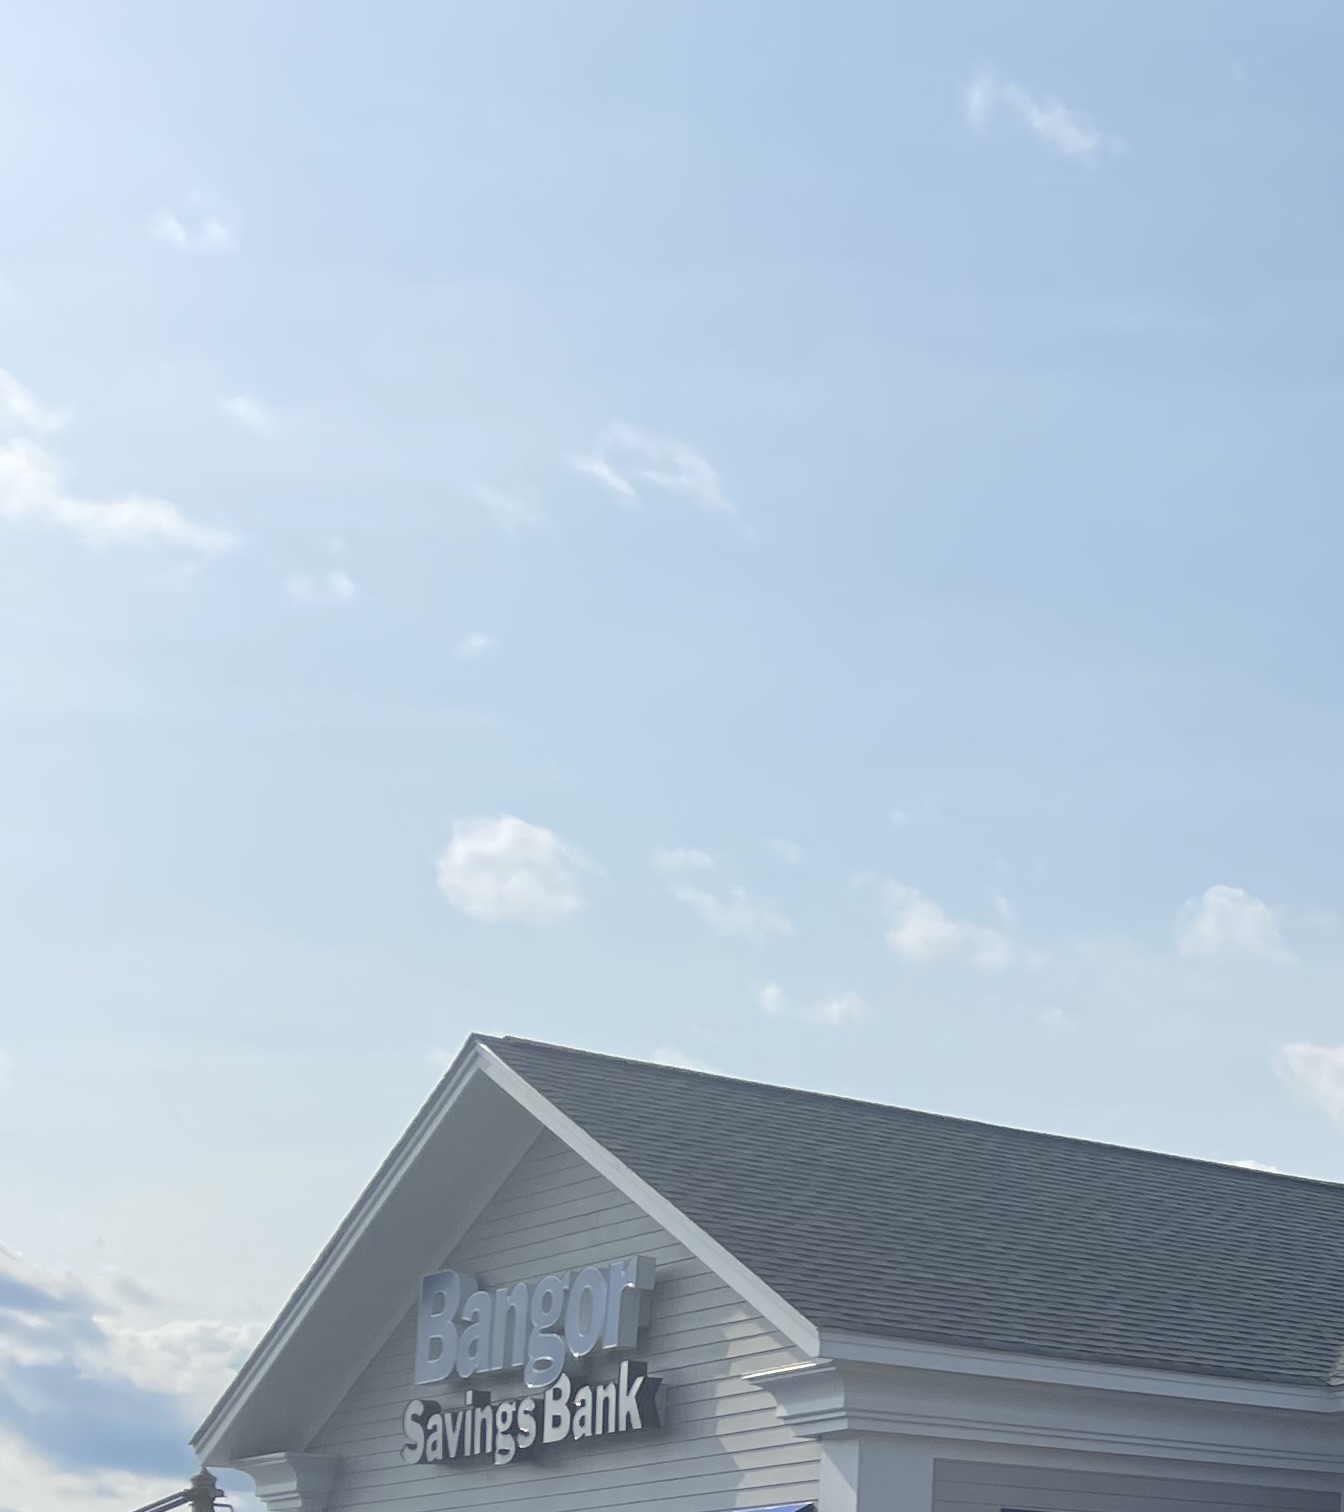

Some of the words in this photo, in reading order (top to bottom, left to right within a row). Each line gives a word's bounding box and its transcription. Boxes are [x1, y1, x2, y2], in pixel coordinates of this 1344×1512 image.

[414, 1256, 640, 1388] Bangor
[401, 1389, 537, 1465] Savings
[543, 1360, 643, 1443] Bank
